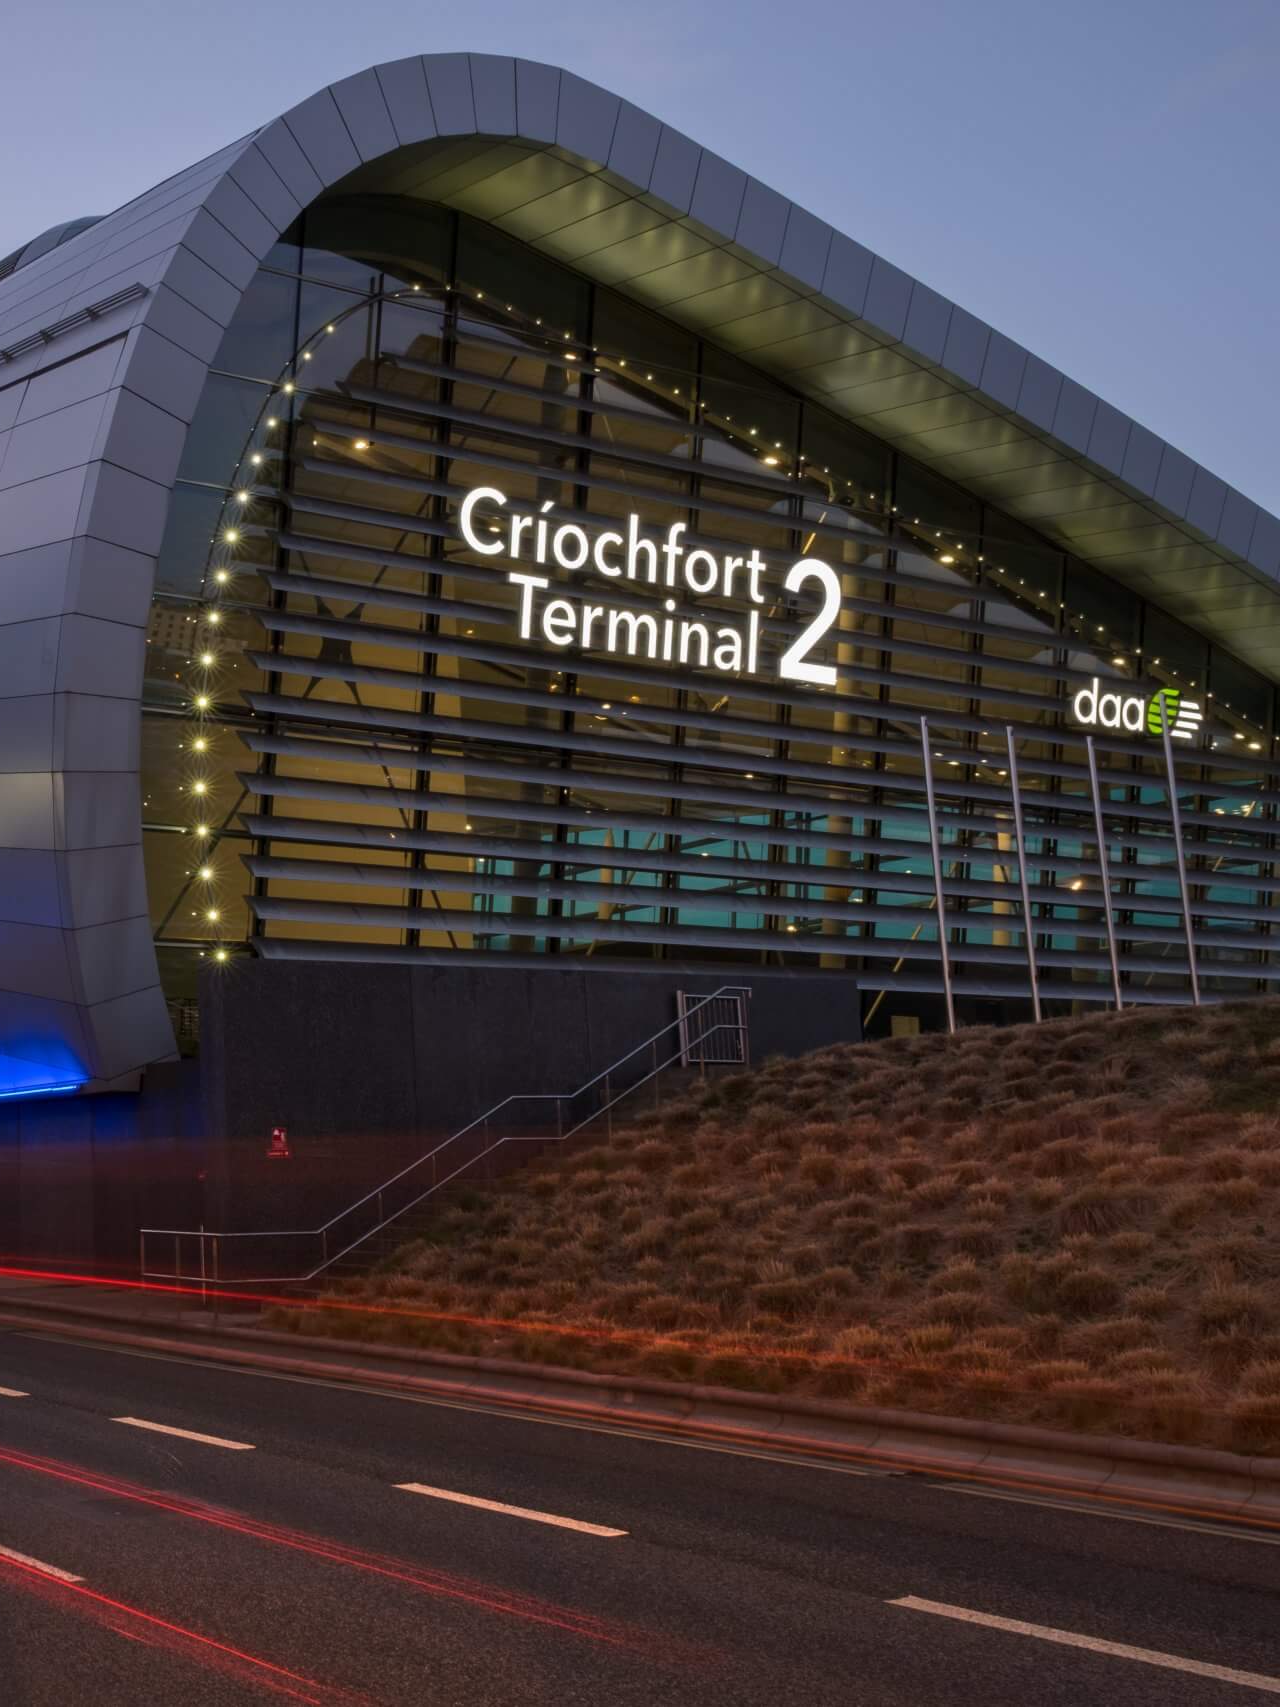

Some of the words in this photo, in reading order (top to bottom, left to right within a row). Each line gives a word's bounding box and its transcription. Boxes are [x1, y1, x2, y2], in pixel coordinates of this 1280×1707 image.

[460, 486, 767, 604] Críochfort
[508, 572, 759, 674] Terminal
[779, 558, 842, 686] 2
[1073, 677, 1145, 732] daa
